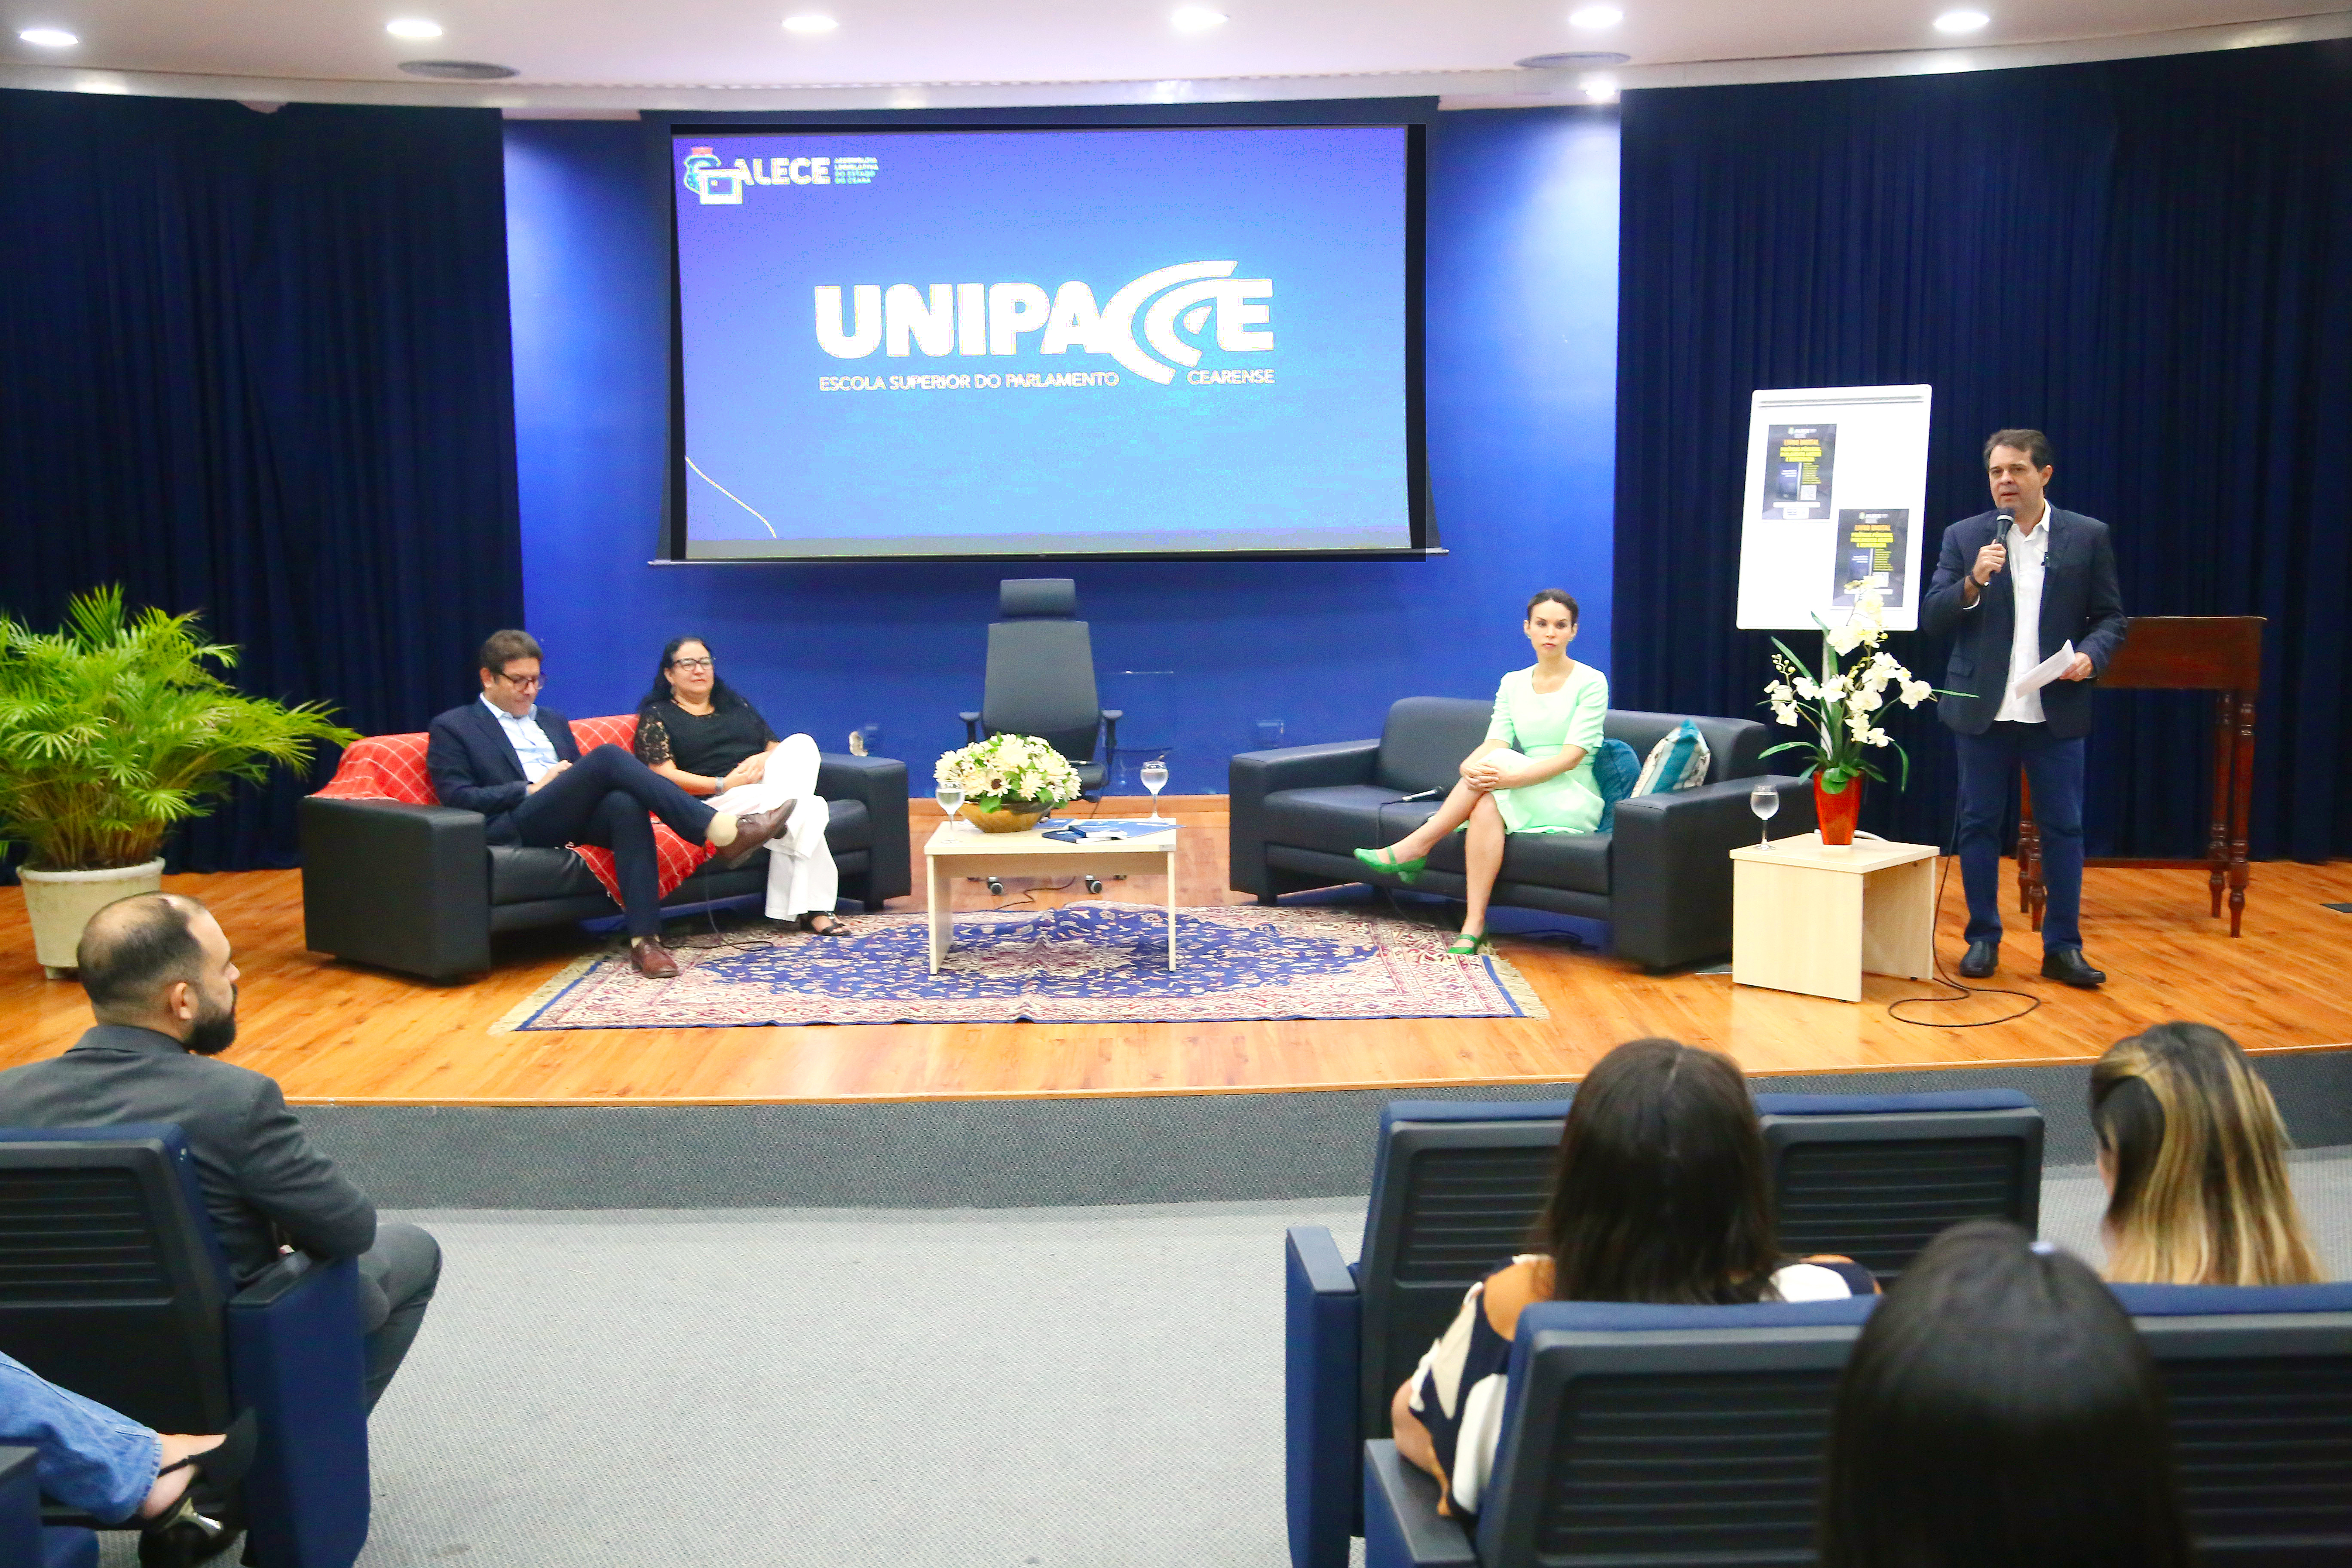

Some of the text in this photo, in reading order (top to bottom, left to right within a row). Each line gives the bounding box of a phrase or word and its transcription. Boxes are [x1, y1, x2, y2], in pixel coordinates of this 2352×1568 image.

[818, 369, 1275, 392] ESCOLA SUPERIOR DO PARLAMENTO CEARENSE
